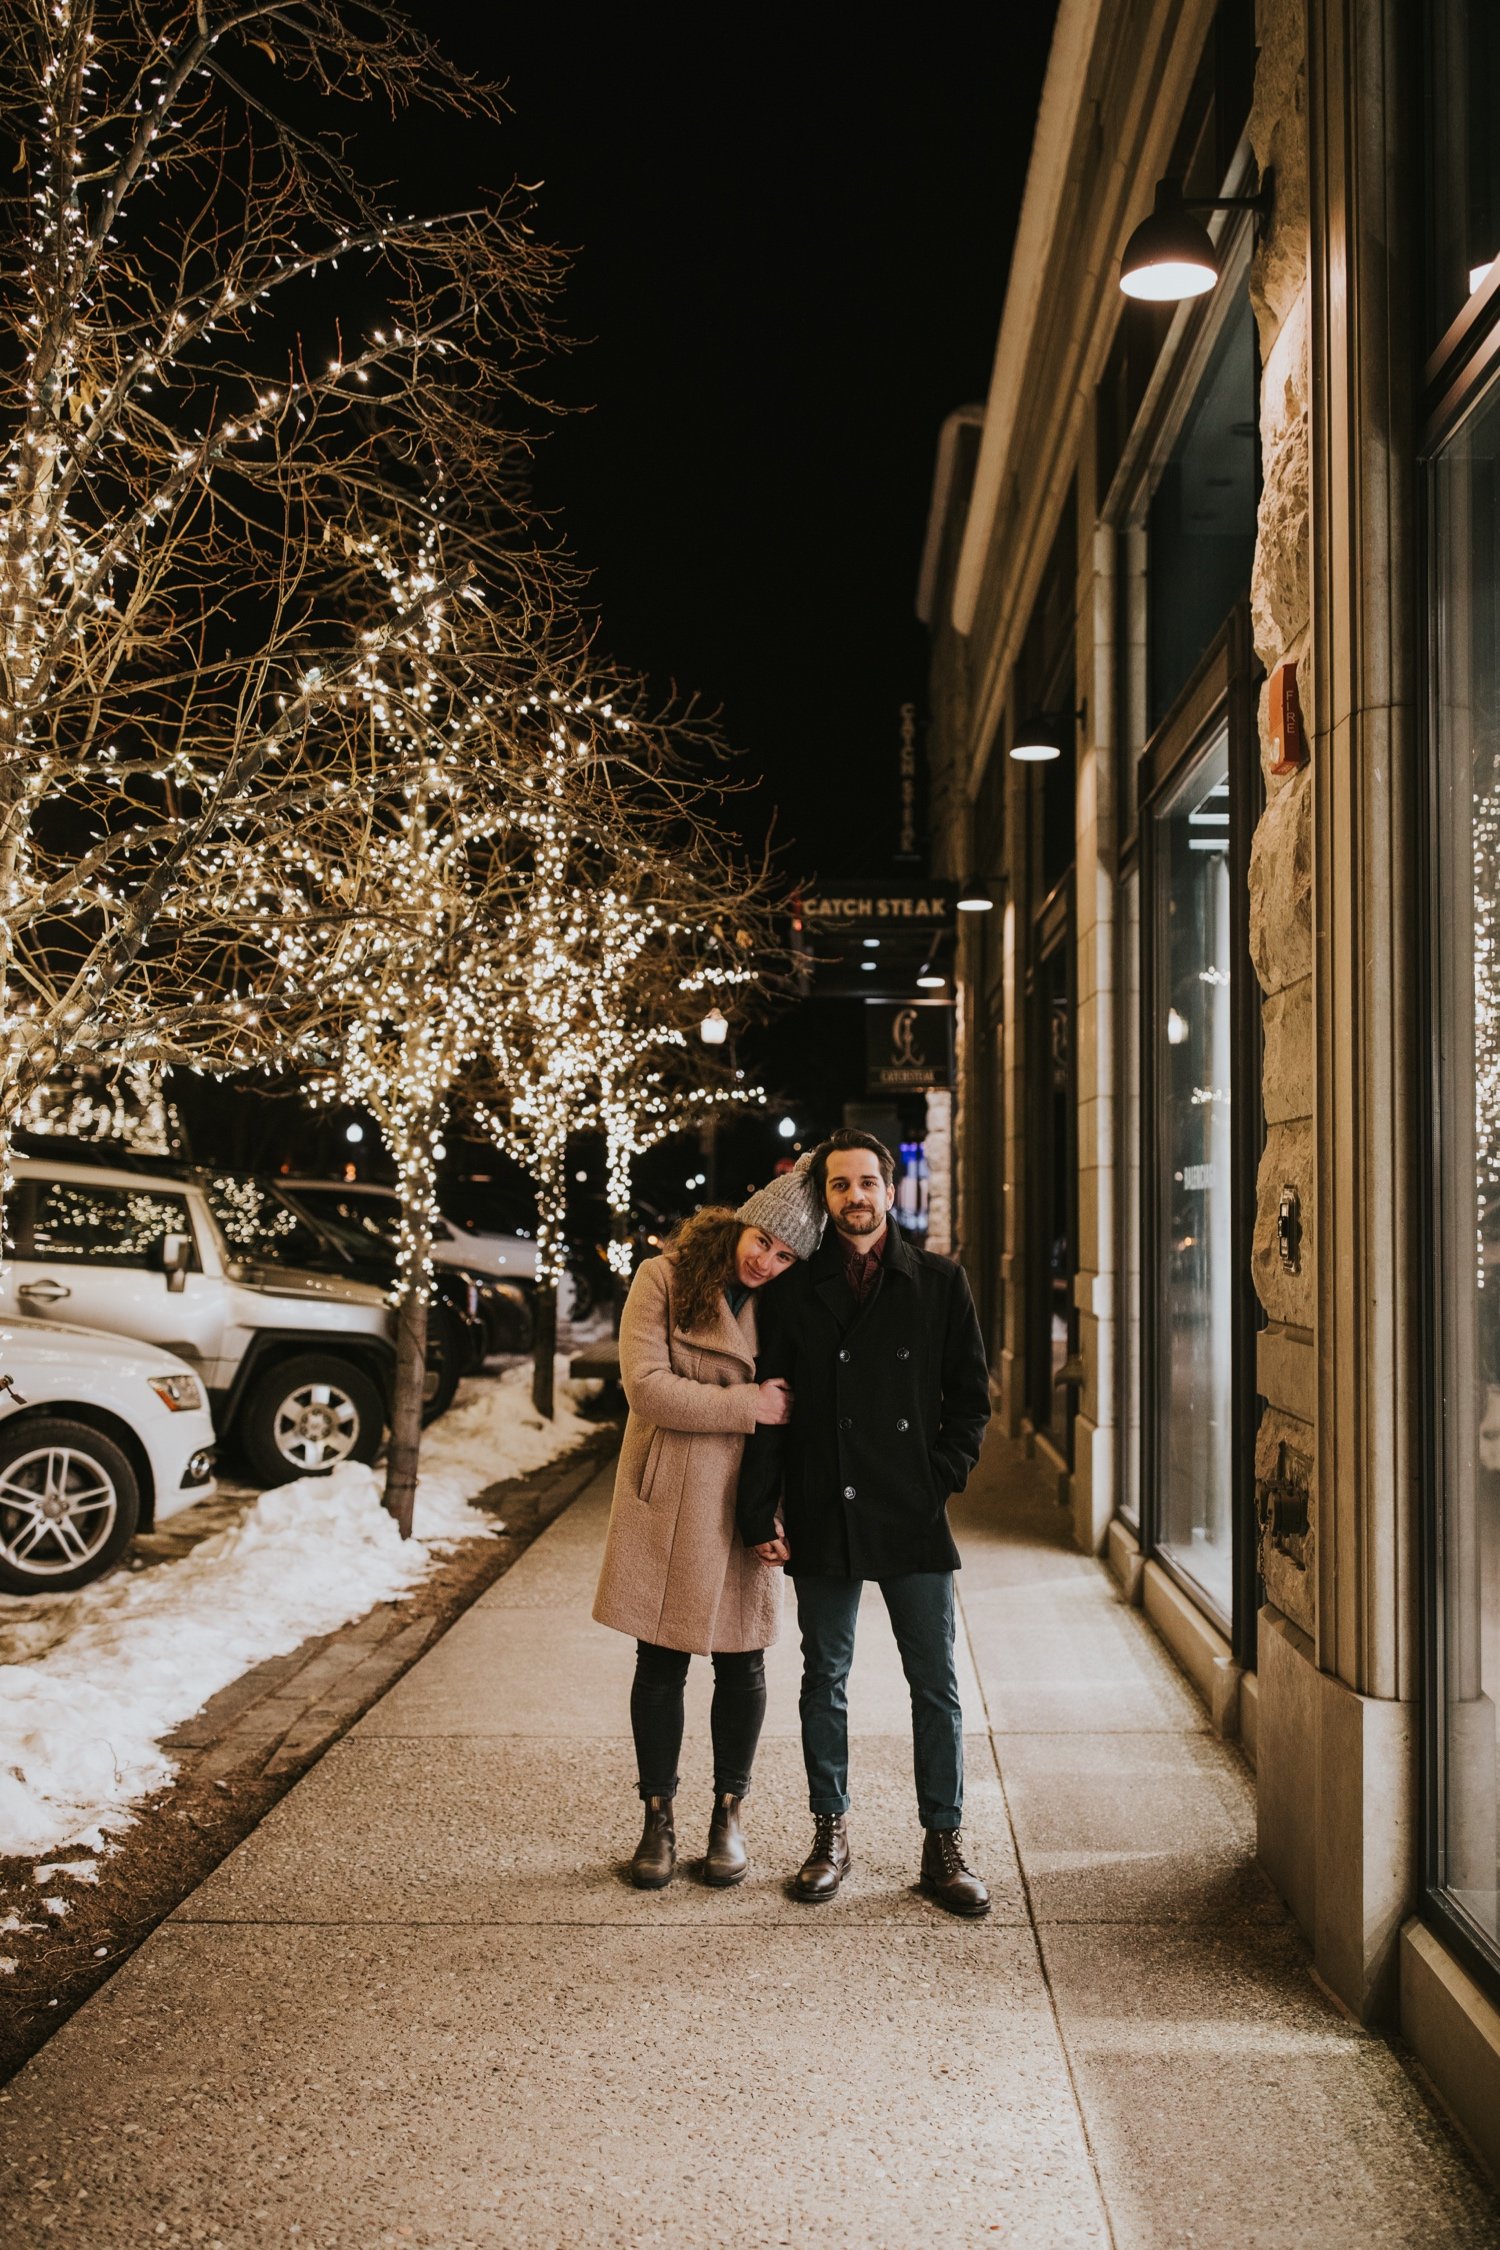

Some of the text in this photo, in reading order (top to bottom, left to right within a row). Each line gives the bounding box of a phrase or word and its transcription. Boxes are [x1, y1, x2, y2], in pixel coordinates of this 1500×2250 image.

[1285, 690, 1296, 734] FIRE
[803, 899, 945, 916] CATCH STEAK
